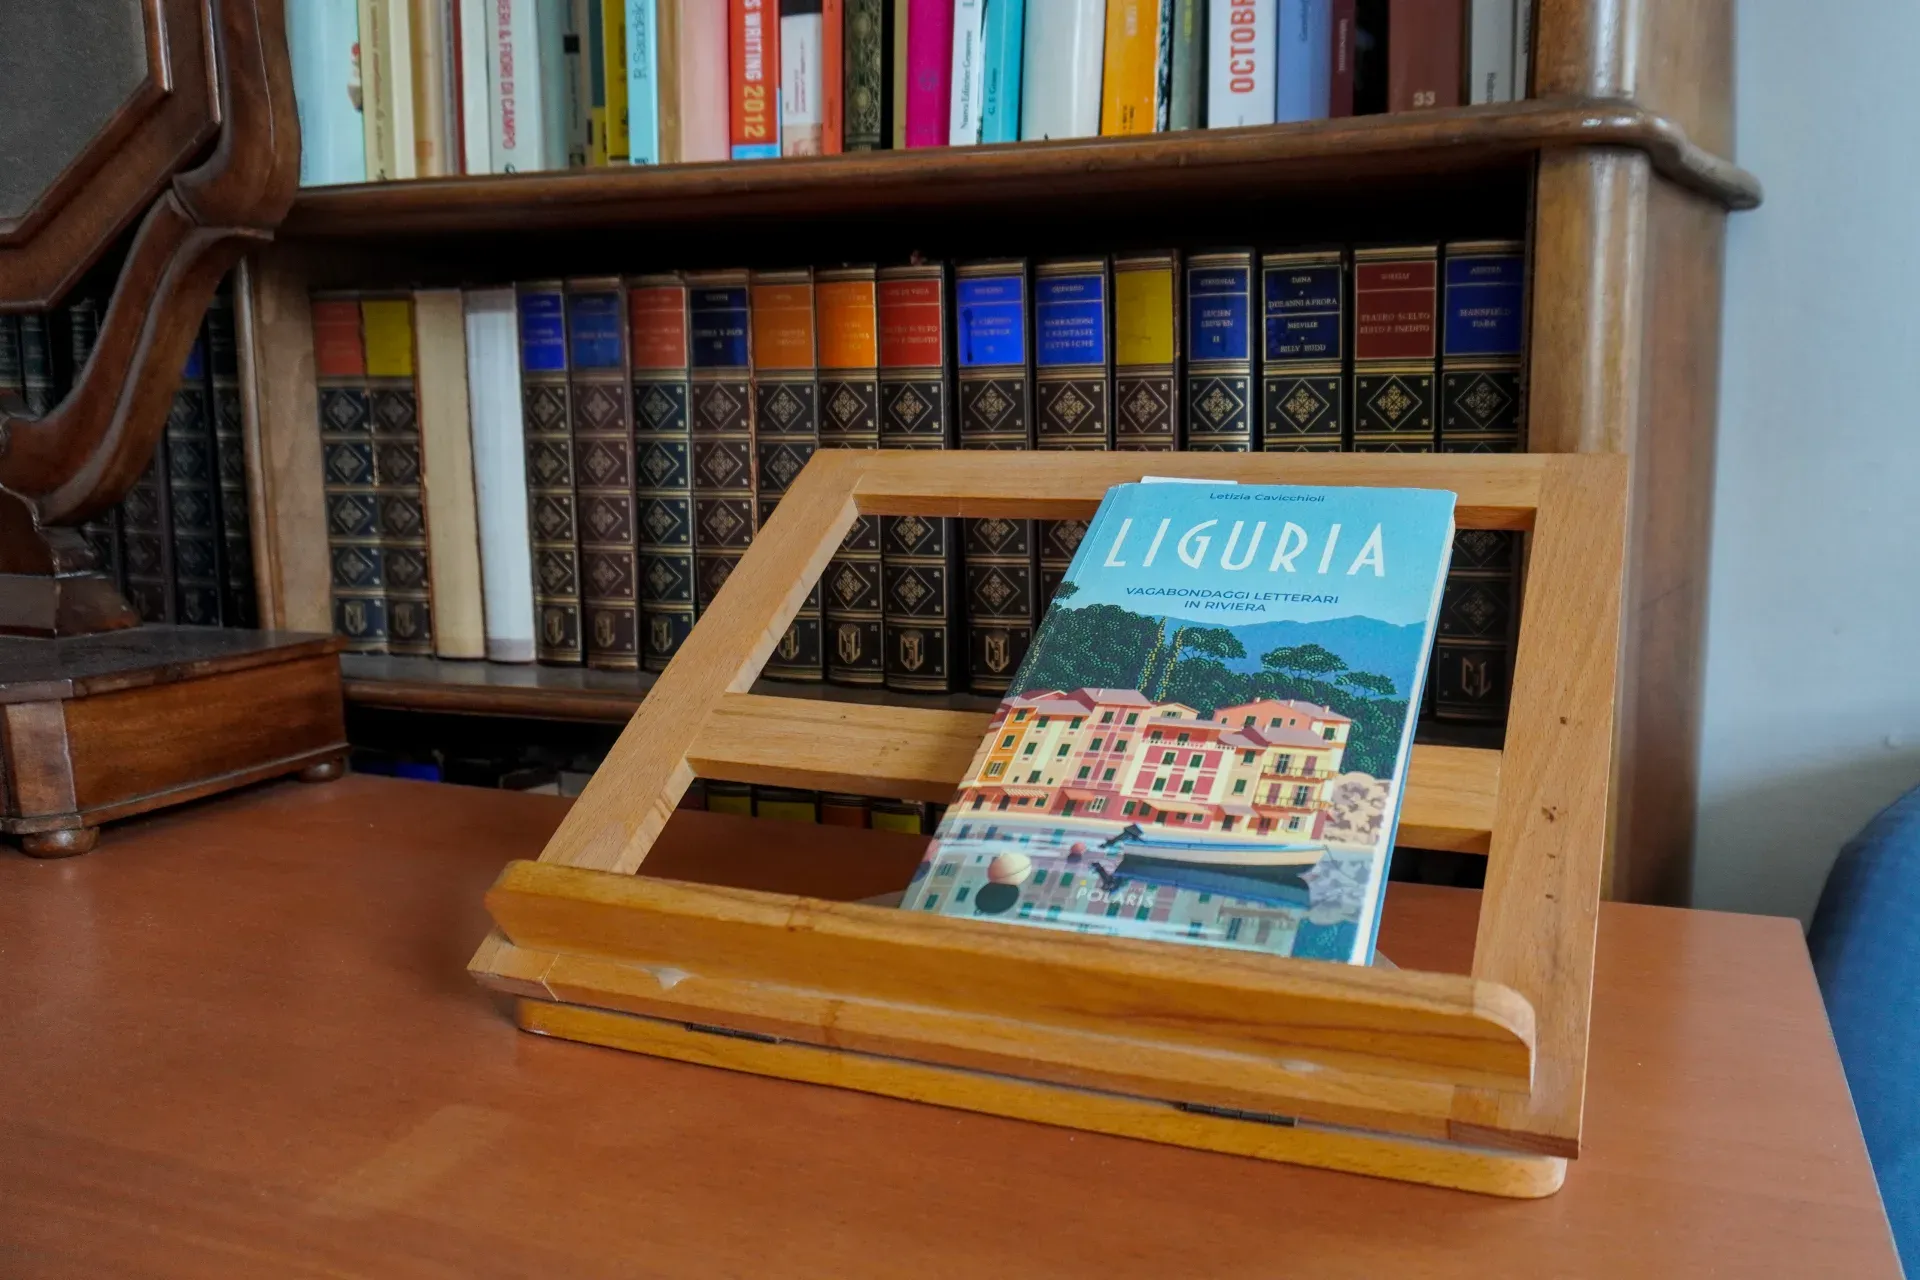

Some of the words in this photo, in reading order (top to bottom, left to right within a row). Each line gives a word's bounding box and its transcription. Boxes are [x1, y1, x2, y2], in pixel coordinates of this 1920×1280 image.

[744, 11, 763, 81] WRITING
[1413, 91, 1436, 107] 33
[743, 84, 766, 139] 2012
[501, 97, 517, 150] CAMPO
[1291, 276, 1312, 284] DANA
[1280, 344, 1301, 353] BILLY
[1303, 343, 1327, 352] BUDD
[1208, 491, 1252, 502] Letizia
[1254, 492, 1326, 503] Cavicchioli
[1103, 517, 1386, 578] LIGURIA
[1125, 586, 1250, 600] VAGABONDAGGI
[1253, 592, 1340, 605] LETTERARI
[1183, 600, 1200, 609] IN
[1202, 602, 1267, 612] RIVIERA
[1075, 886, 1154, 909] POLARIS
